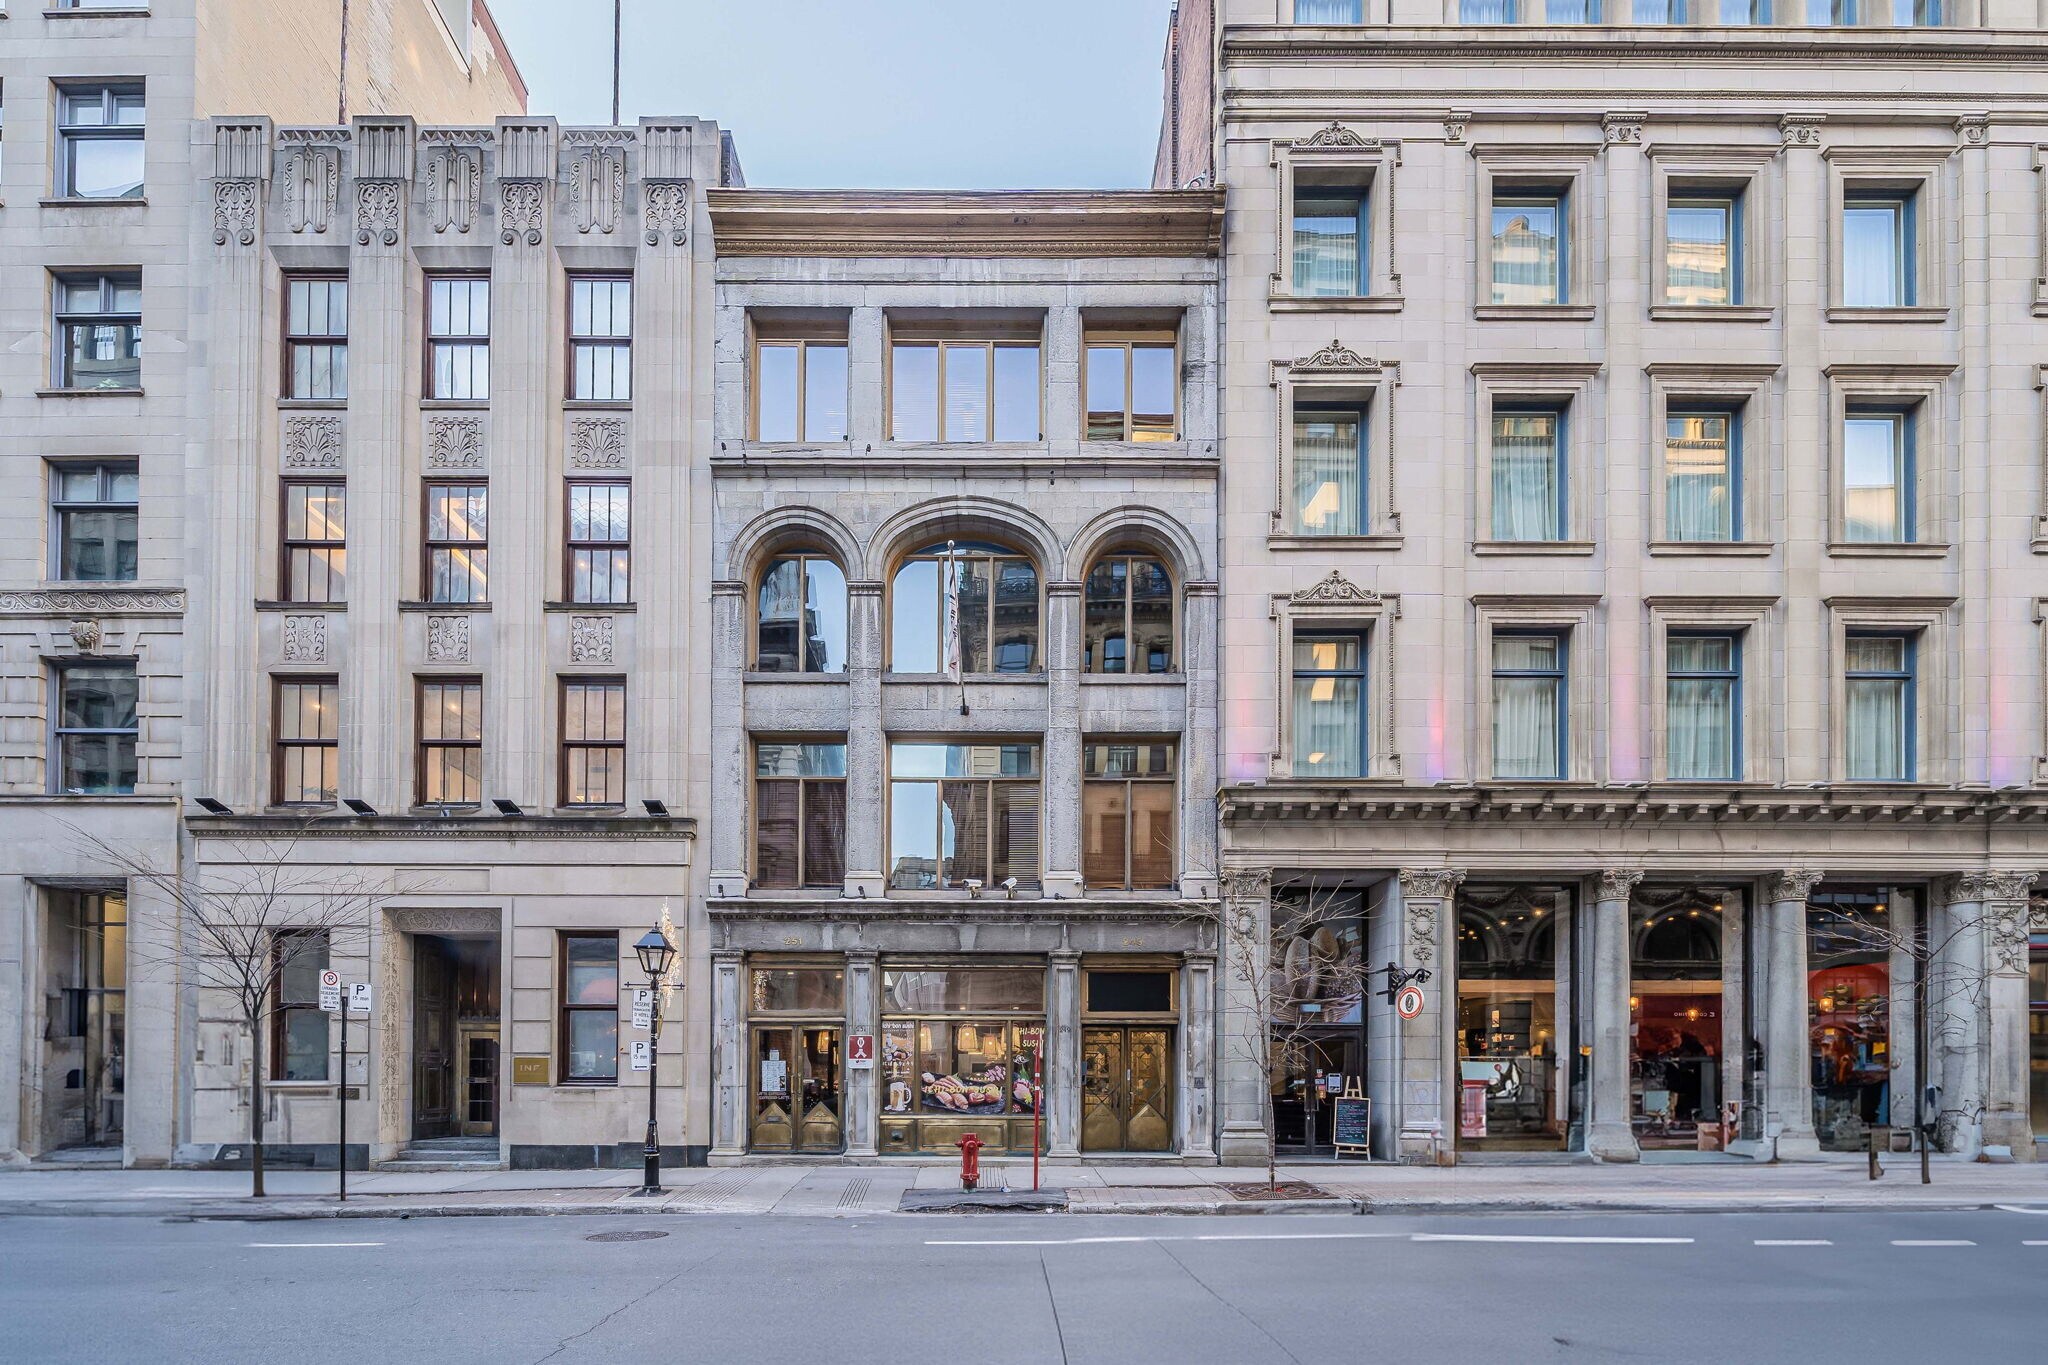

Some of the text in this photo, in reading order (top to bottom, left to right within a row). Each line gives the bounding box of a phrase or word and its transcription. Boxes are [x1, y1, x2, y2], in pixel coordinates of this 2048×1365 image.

[784, 936, 802, 945] 251
[356, 984, 365, 995] P
[640, 991, 647, 1001] P
[636, 1043, 644, 1053] P
